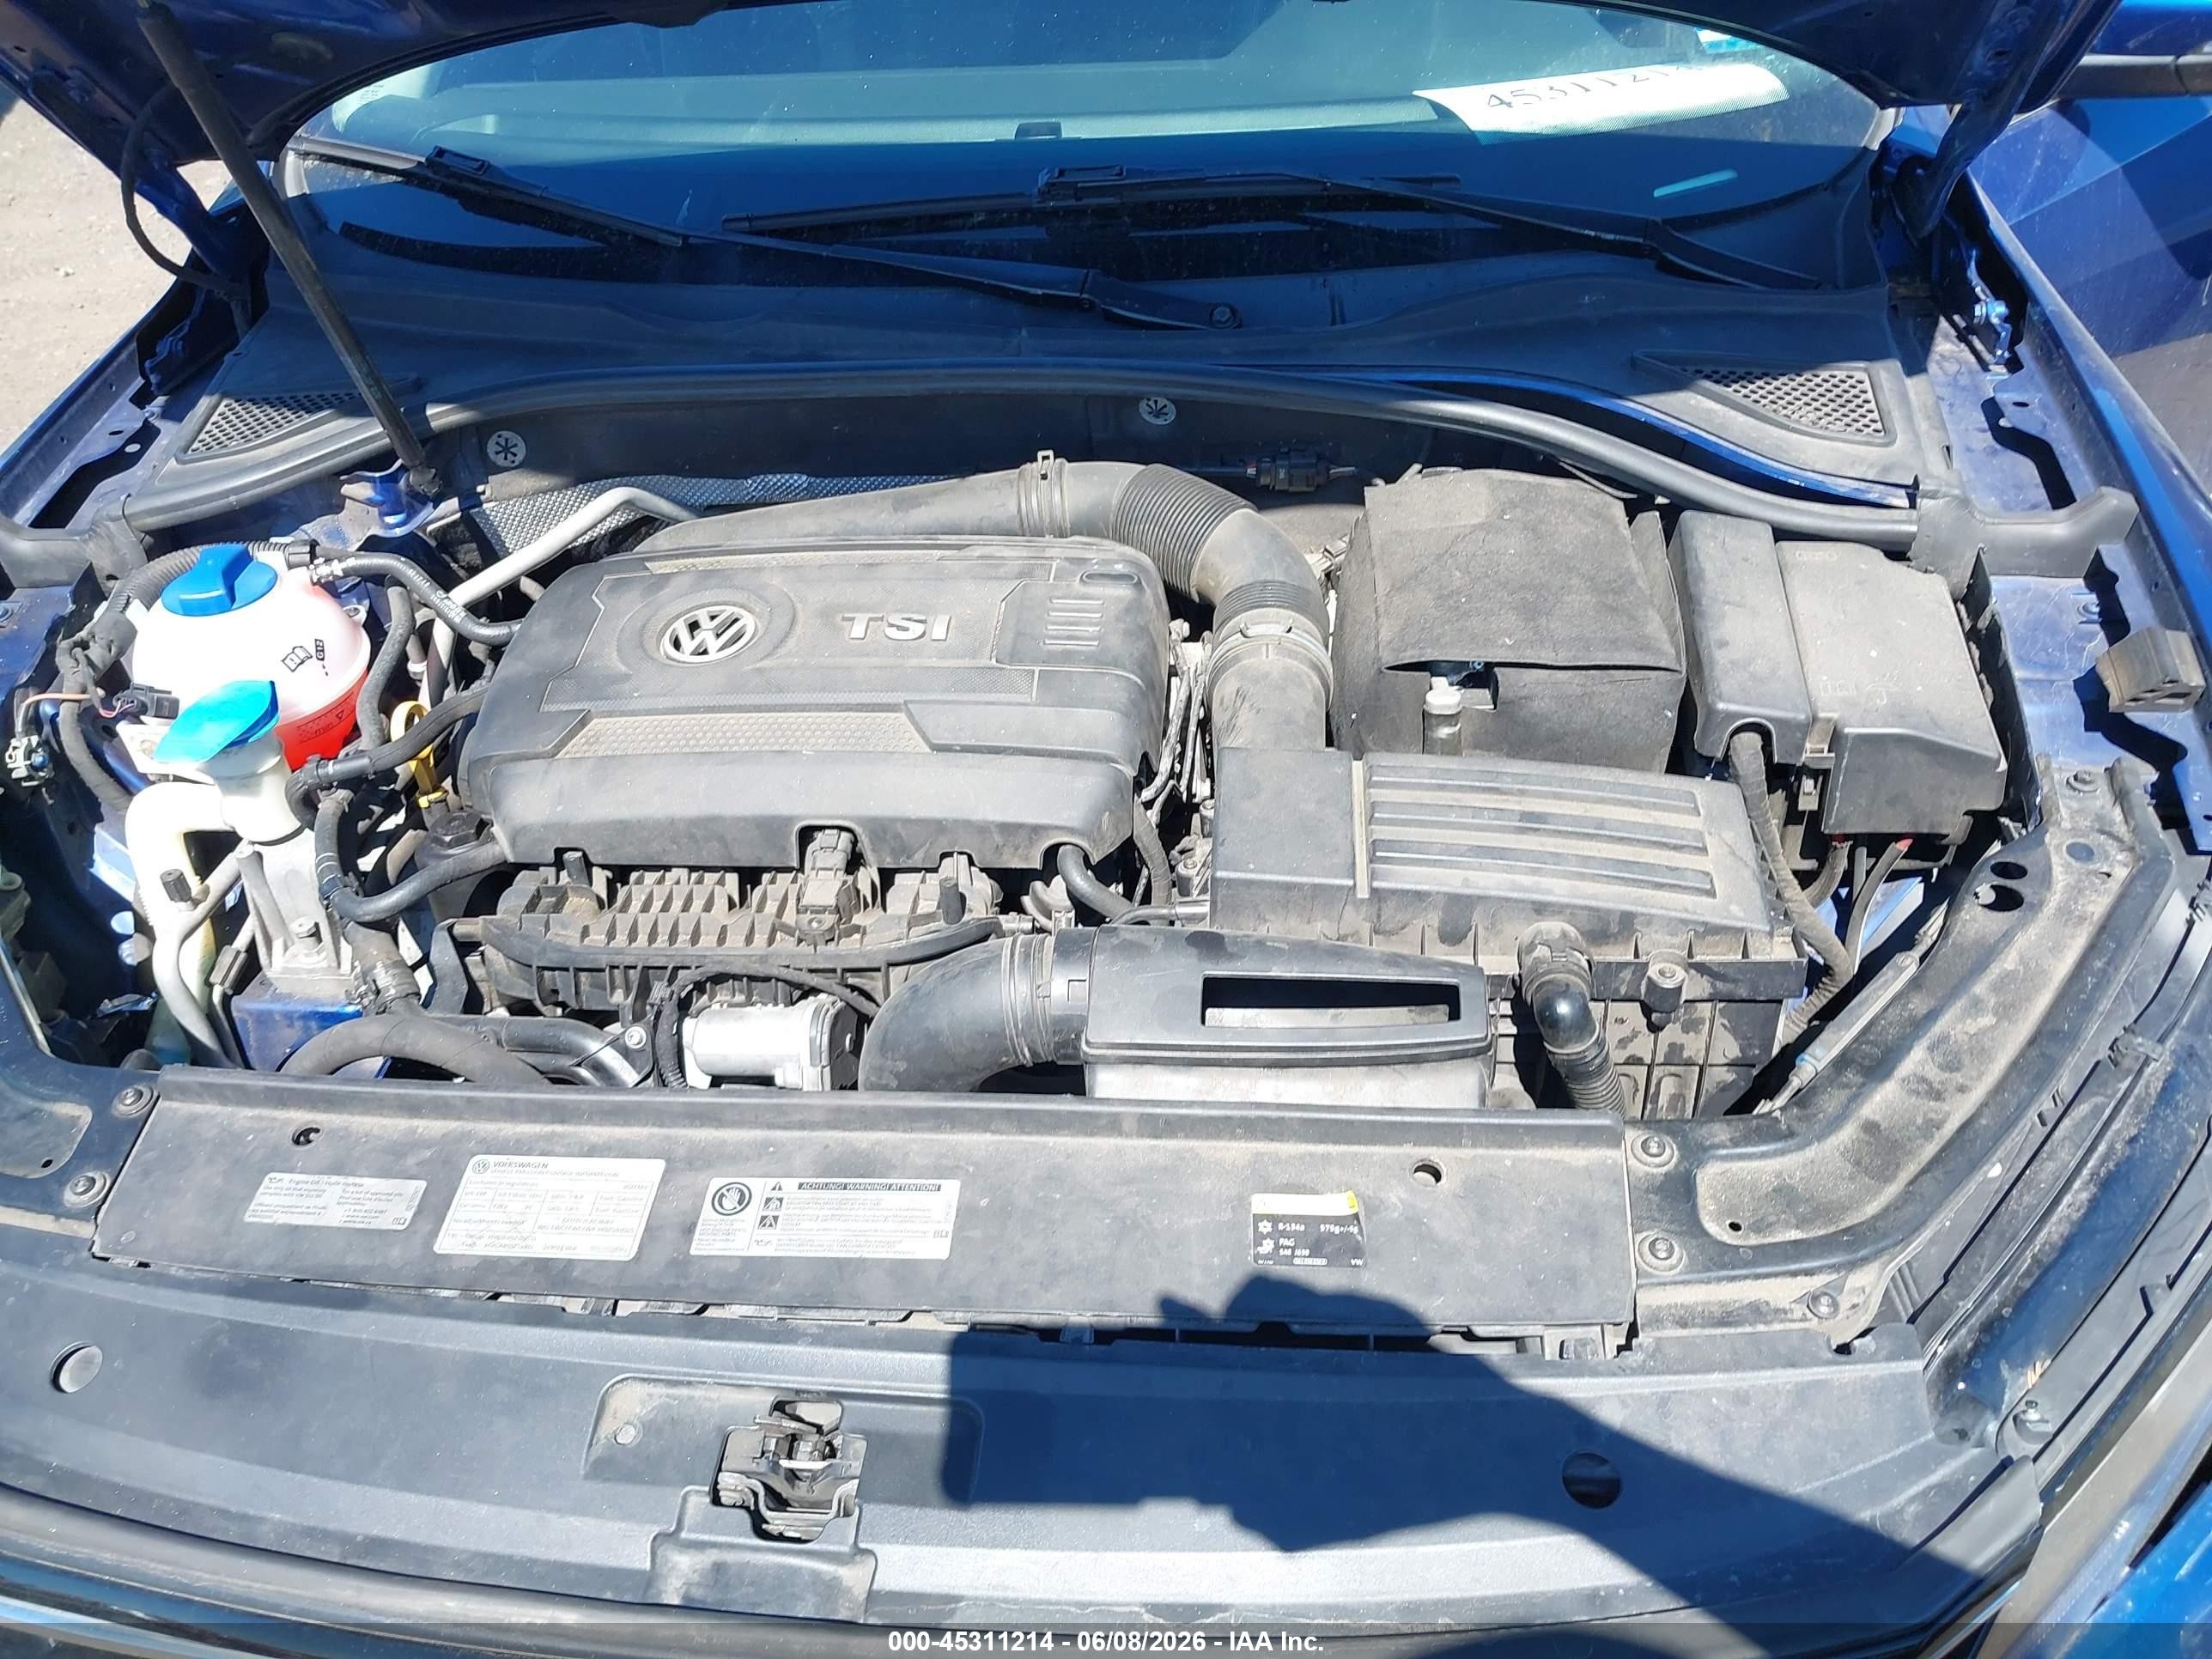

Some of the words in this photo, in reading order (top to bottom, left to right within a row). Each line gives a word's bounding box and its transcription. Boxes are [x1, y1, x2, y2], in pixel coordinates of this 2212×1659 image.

[842, 613, 951, 641] TSI
[846, 1182, 890, 1191] WARNING!
[890, 1183, 939, 1192] ATTENTION!
[1279, 1237, 1296, 1247] PAG
